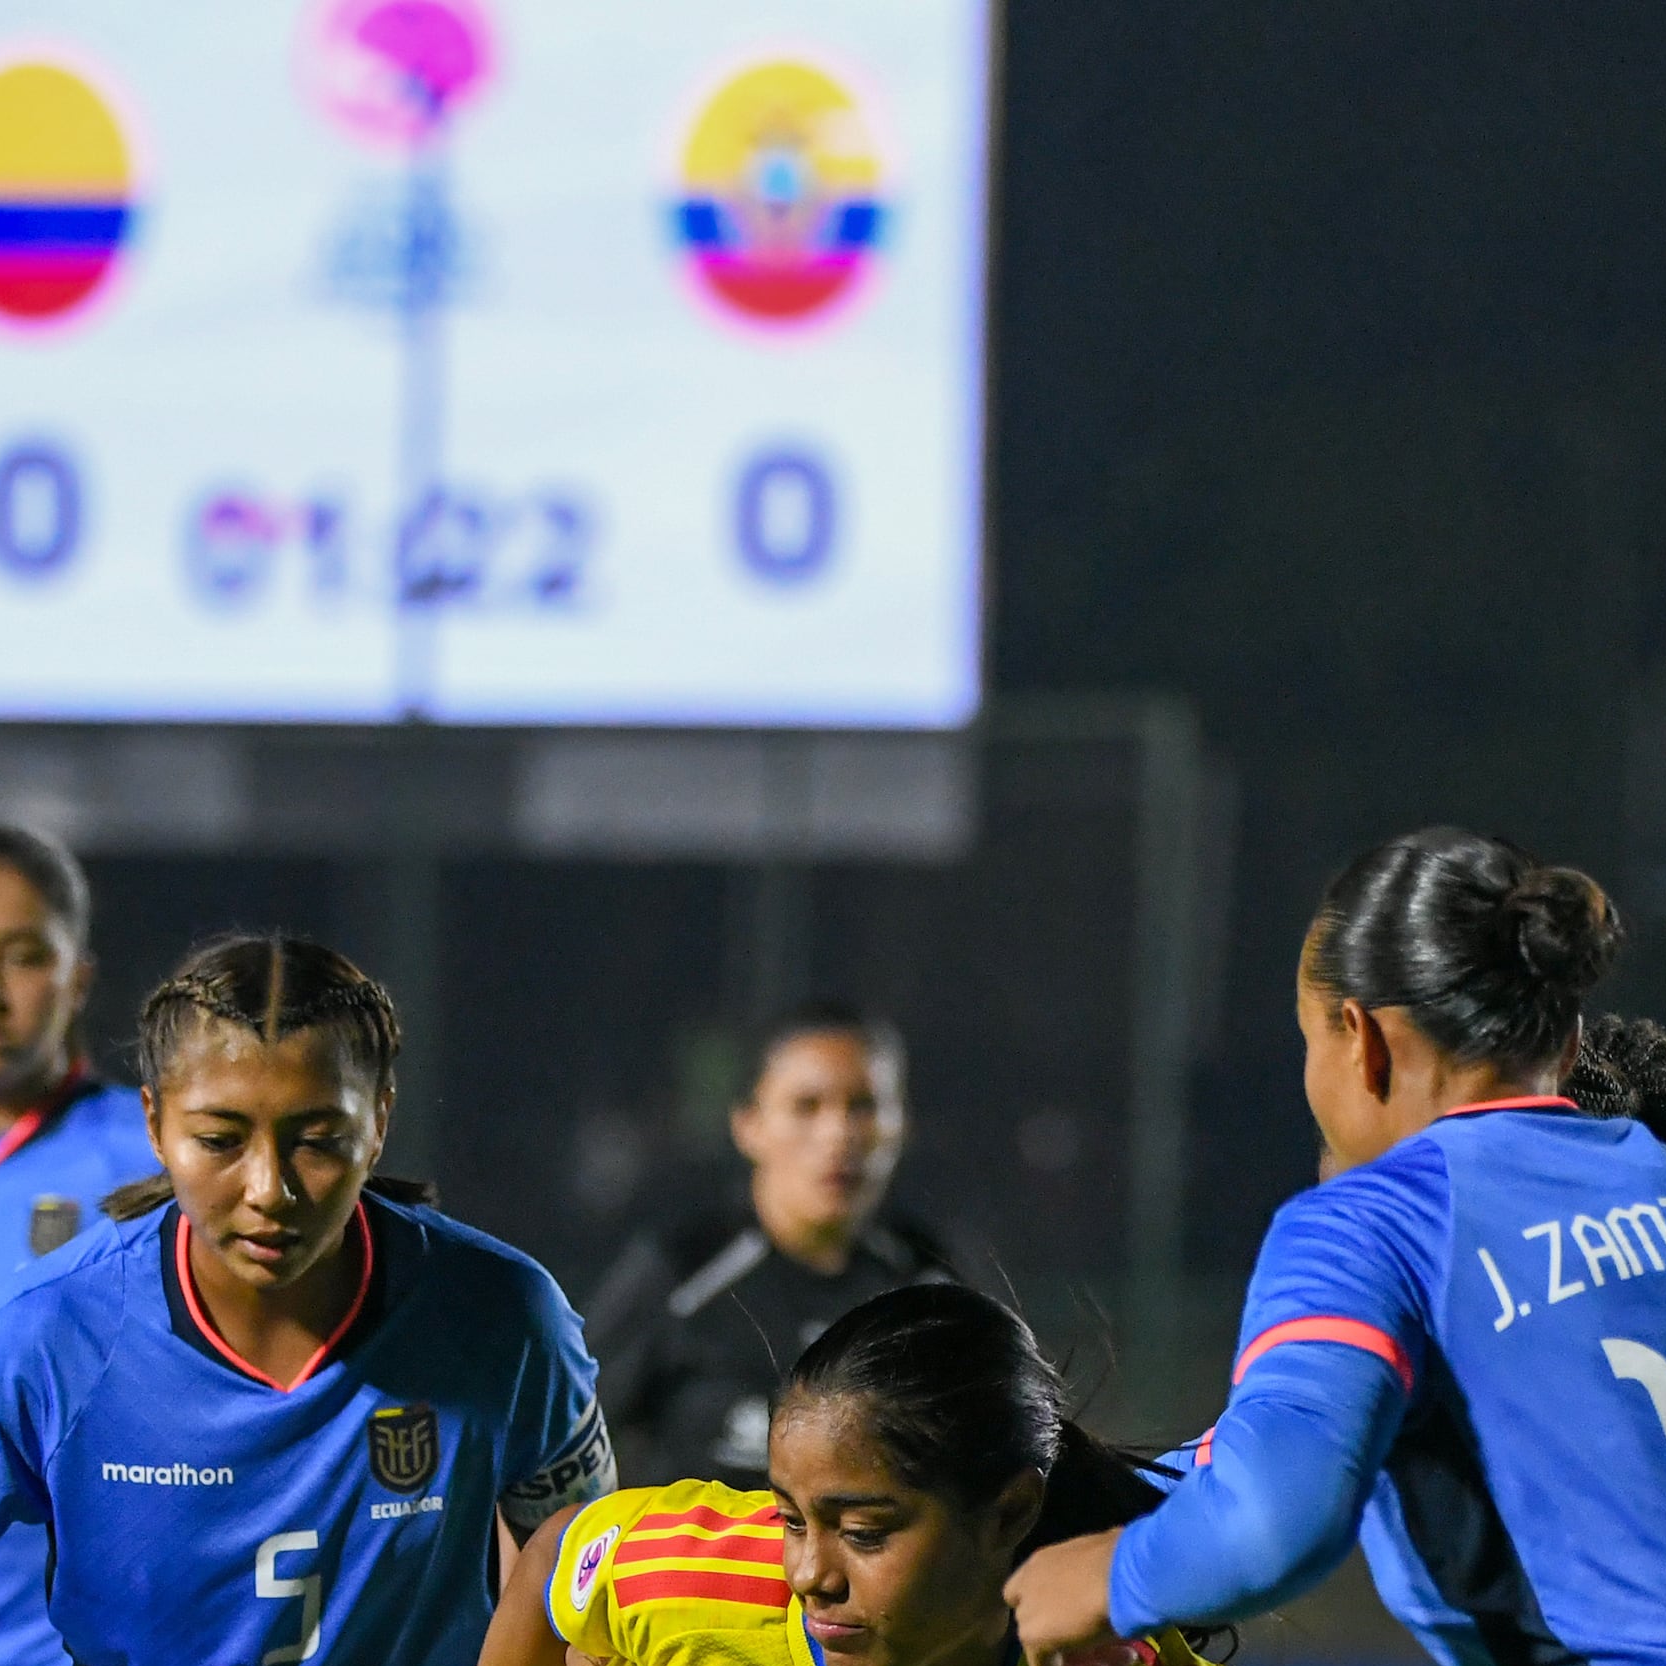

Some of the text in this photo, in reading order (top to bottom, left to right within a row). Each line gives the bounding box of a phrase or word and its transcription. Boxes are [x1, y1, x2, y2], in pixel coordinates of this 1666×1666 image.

[732, 440, 839, 588] 0
[1477, 1247, 1532, 1333] J.
[101, 1461, 234, 1487] marathon
